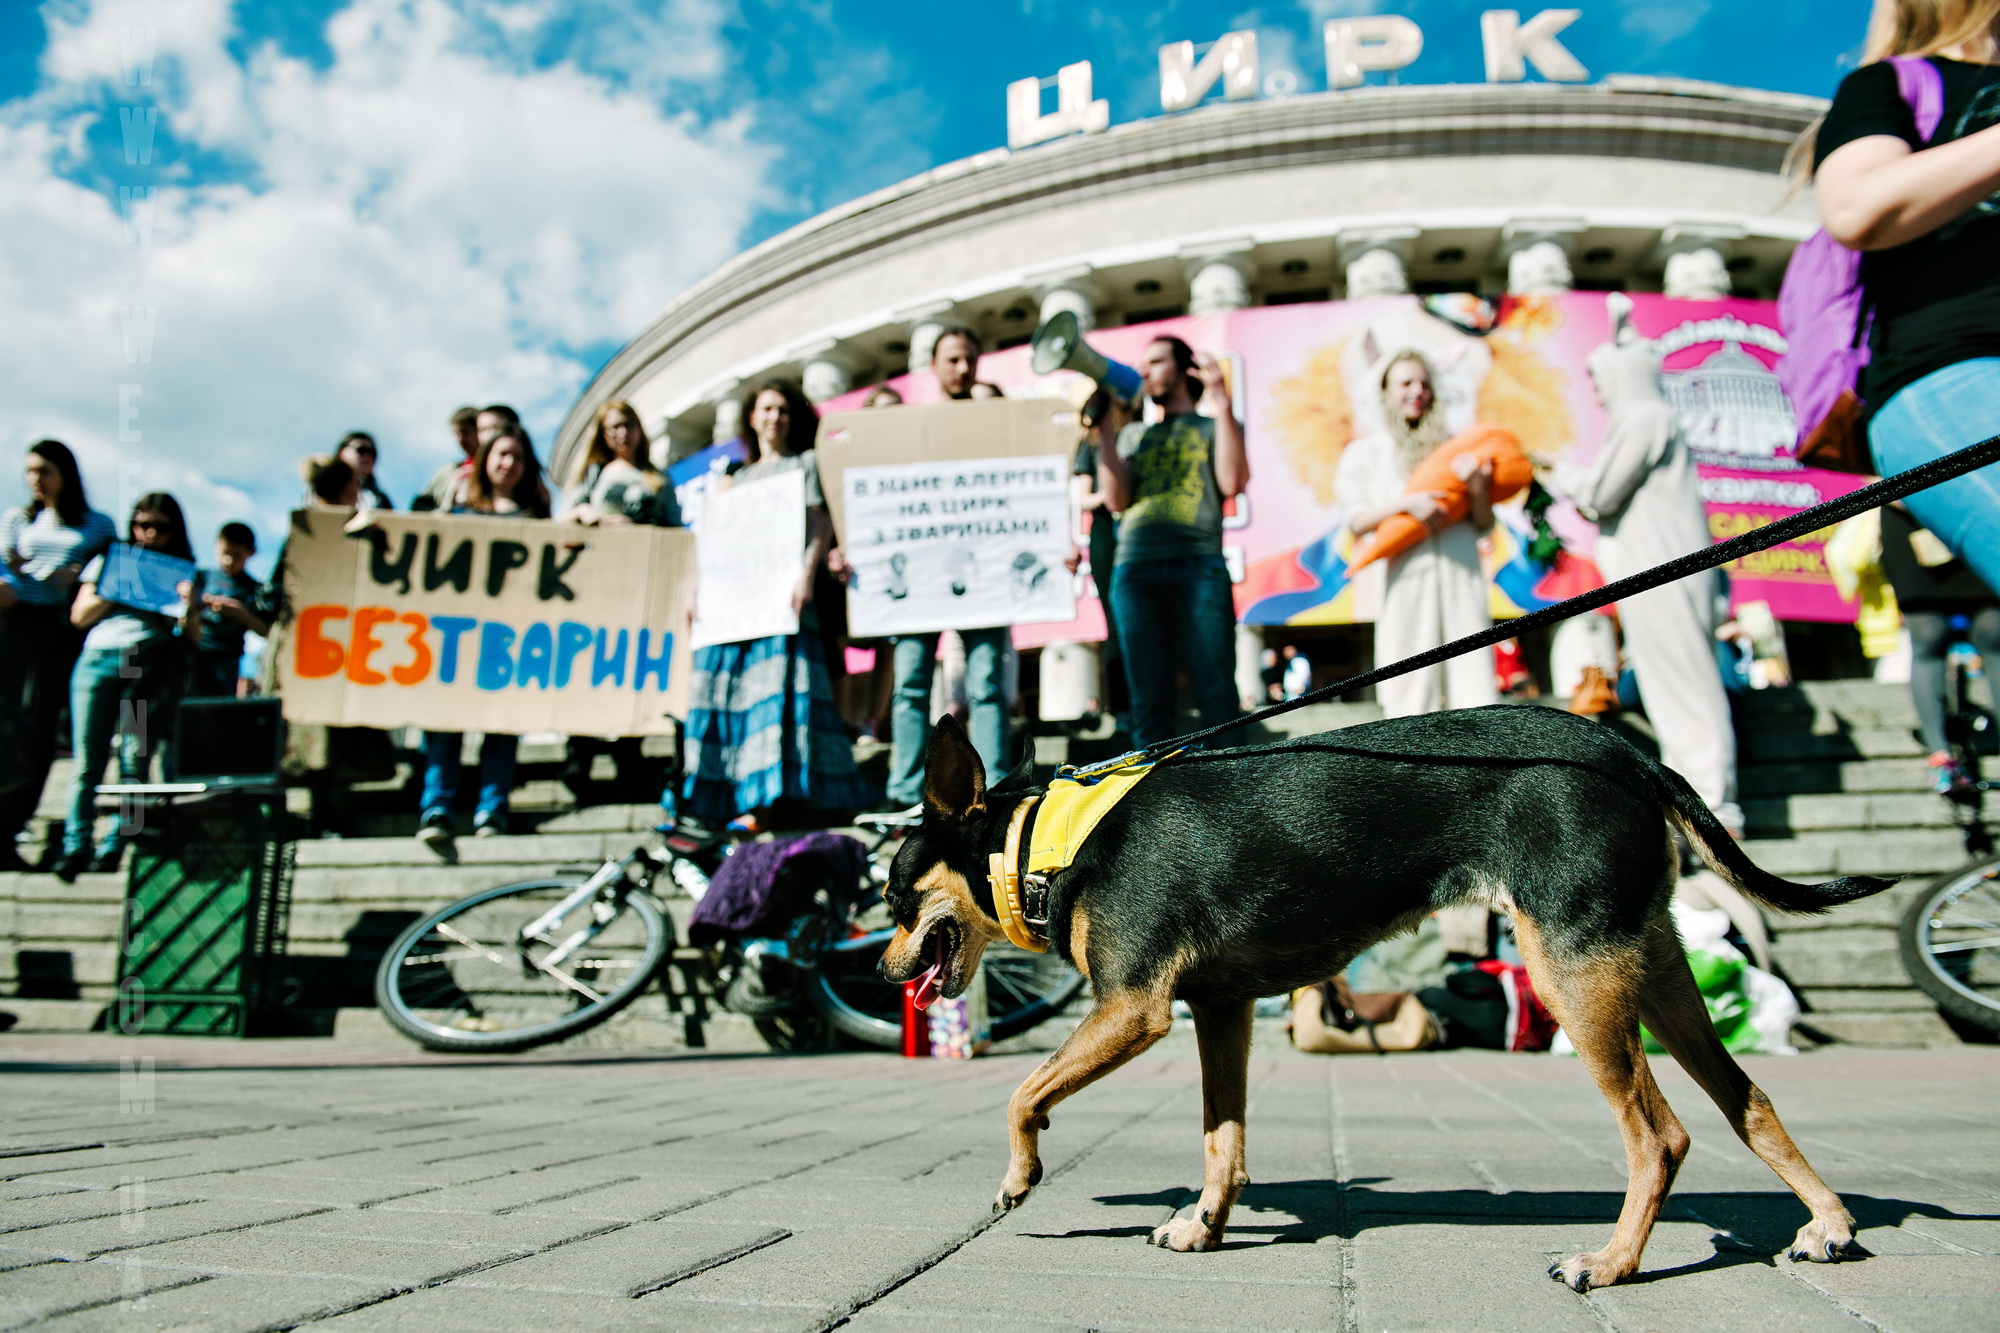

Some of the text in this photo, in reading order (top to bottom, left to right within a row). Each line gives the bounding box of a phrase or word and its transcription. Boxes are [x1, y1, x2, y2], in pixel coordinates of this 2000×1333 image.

[1007, 8, 1590, 149] ЦИРК
[898, 495, 1011, 516] НА ЦИРК
[368, 530, 586, 602] ЦИРК
